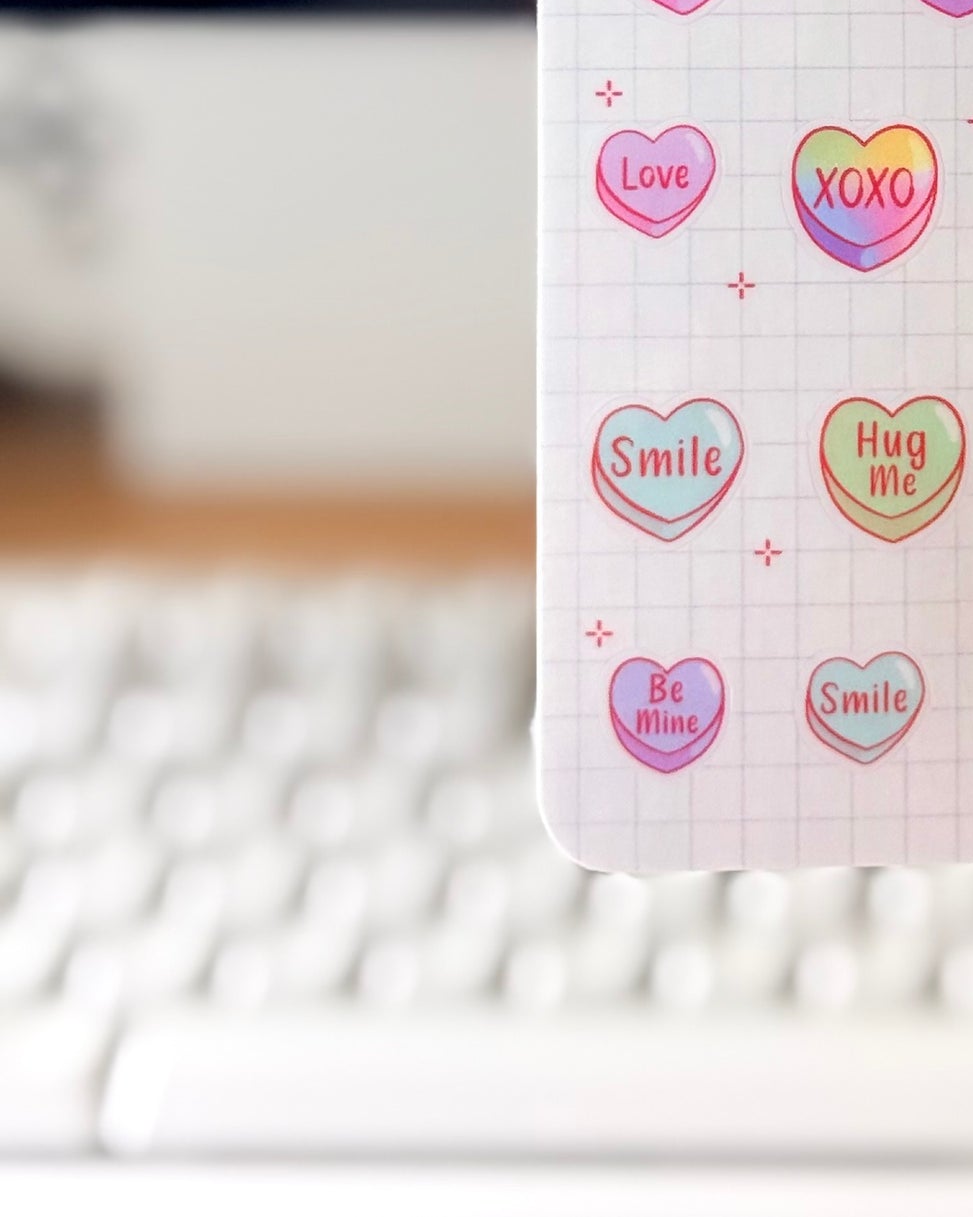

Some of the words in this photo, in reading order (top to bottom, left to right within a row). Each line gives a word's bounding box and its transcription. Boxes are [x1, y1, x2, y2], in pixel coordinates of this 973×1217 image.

[621, 155, 690, 191] Love
[812, 166, 916, 209] XOXO
[610, 432, 723, 479] Smile
[857, 420, 926, 468] Hug
[870, 463, 918, 498] Me
[649, 672, 684, 705] Be
[819, 681, 908, 716] Smile
[635, 707, 699, 737] Mine
